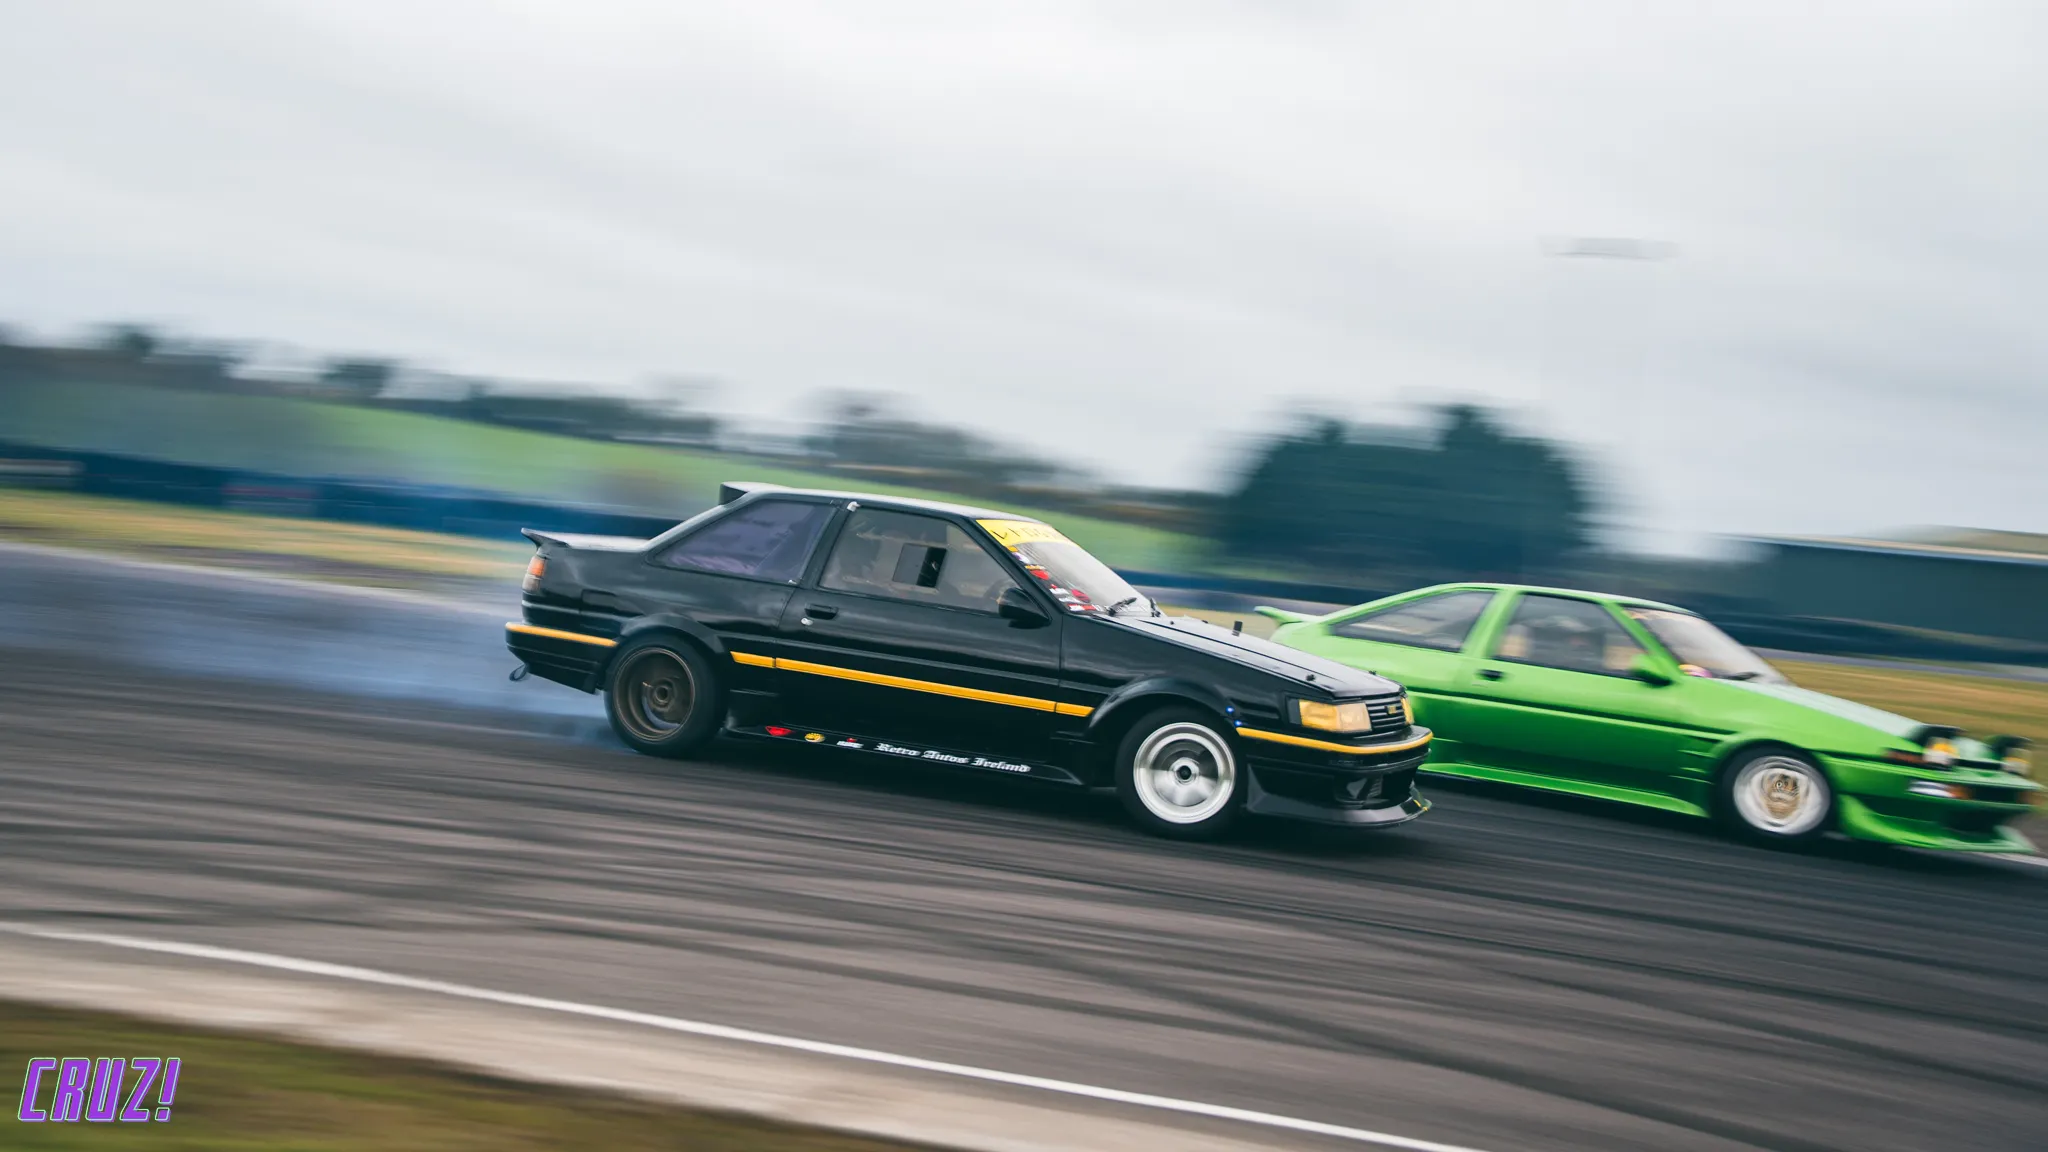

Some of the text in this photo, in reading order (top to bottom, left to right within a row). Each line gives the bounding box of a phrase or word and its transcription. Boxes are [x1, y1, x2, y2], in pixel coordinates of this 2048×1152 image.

[874, 742, 920, 756] Retro
[922, 750, 969, 764] Autos
[971, 757, 1031, 772] Ireland
